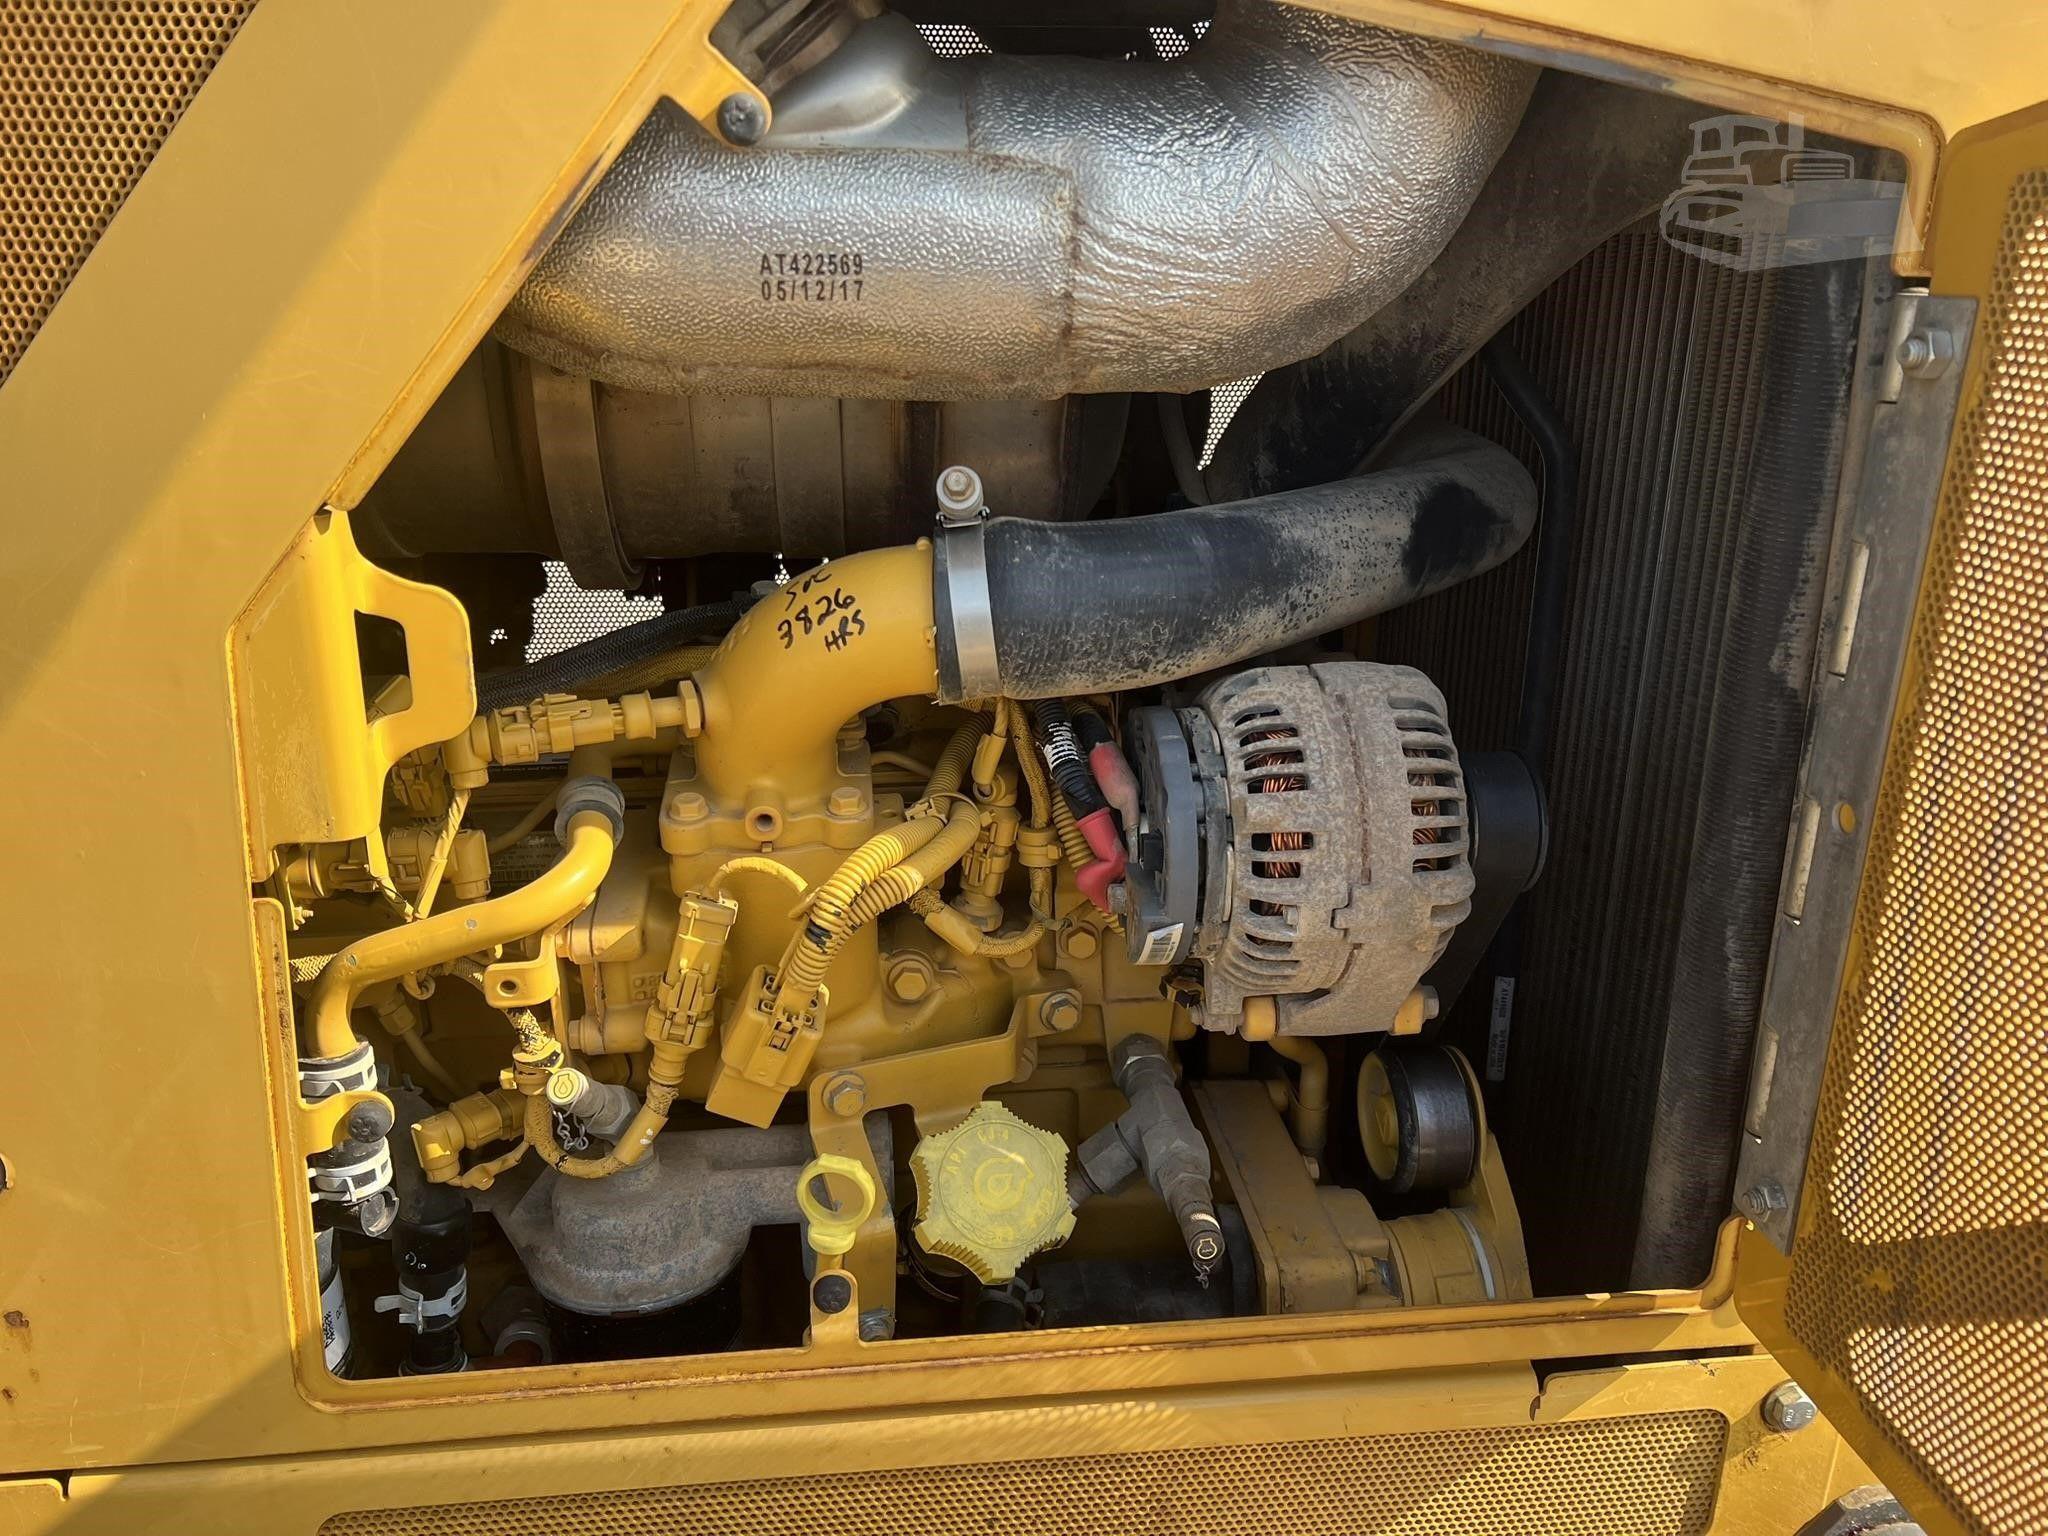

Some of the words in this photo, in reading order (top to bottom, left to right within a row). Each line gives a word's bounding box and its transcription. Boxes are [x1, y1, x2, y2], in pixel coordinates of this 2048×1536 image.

[760, 253, 863, 276] AT422569
[761, 280, 864, 301] 05/12/17
[777, 587, 857, 649] 3826
